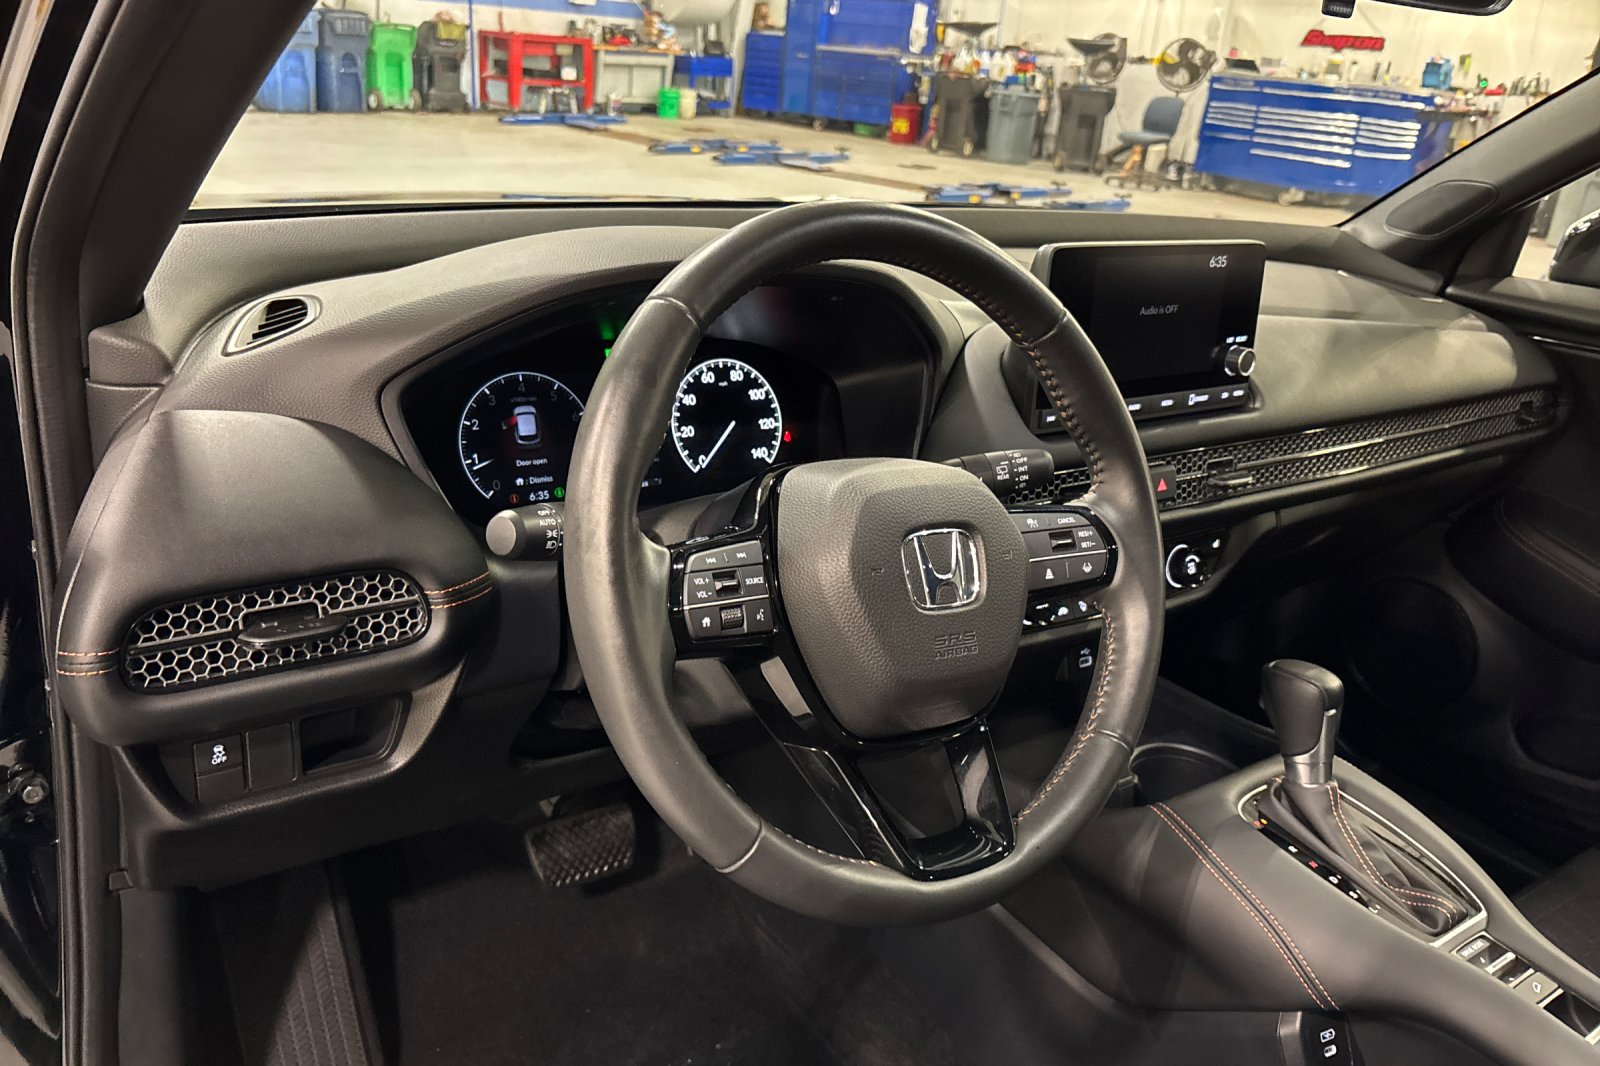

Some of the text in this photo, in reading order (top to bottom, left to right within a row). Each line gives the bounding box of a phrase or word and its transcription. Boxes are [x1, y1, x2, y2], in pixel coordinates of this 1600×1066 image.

[1209, 255, 1228, 268] 6:35
[1140, 304, 1179, 315] Audio is OFF
[701, 371, 715, 383] 60
[730, 369, 744, 381] 80
[518, 383, 526, 393] 4
[682, 394, 696, 405] 40
[748, 389, 766, 400] 100
[488, 395, 496, 406] 3
[471, 418, 480, 431] 2
[758, 417, 776, 430] 120
[680, 425, 695, 438] 20
[751, 447, 769, 459] 140
[472, 453, 479, 465] 1
[516, 458, 548, 467] Door open
[1018, 465, 1028, 473] INT
[529, 474, 554, 485] Dismiss
[1019, 474, 1029, 482] ON
[492, 479, 501, 491] 0
[529, 490, 550, 502] 6:35
[1057, 516, 1076, 525] CANCEL
[693, 578, 705, 586] VOL
[745, 576, 765, 586] SOURCE
[696, 591, 708, 599] VOL
[211, 756, 228, 765] OFF
[1329, 876, 1338, 884] D
